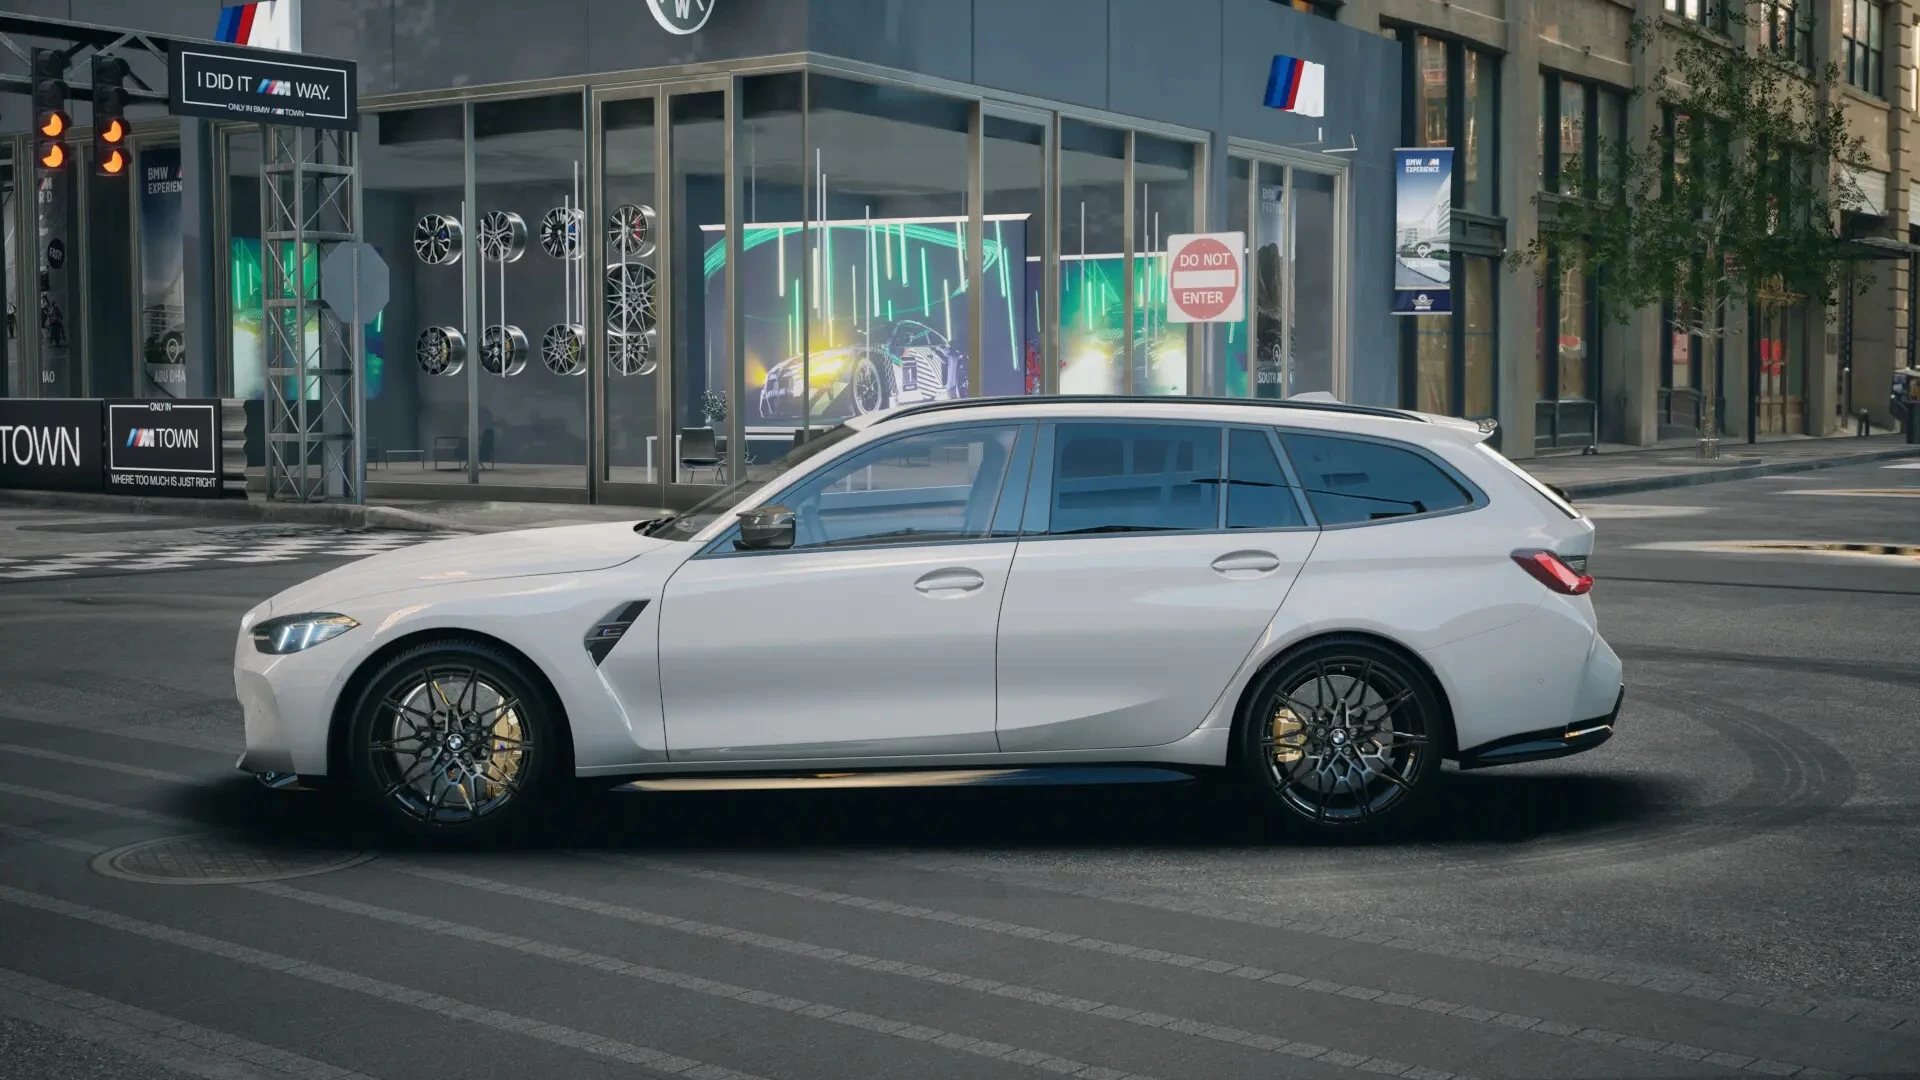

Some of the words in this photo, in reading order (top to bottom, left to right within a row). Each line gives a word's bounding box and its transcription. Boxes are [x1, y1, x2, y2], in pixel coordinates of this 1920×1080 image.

[197, 71, 201, 87] I
[206, 72, 233, 90] DID
[238, 75, 252, 92] IT
[296, 82, 330, 101] WAY.
[228, 103, 245, 111] ONLY
[285, 108, 304, 117] TOWN
[1405, 158, 1422, 166] BMW
[148, 167, 168, 180] BMW
[148, 181, 183, 194] EXPERIEN
[1180, 253, 1199, 267] DO
[1203, 252, 1231, 266] NOT
[1182, 291, 1224, 304] ENTER
[170, 369, 186, 383] DHA
[150, 402, 165, 411] ONLY
[165, 402, 171, 411] IN
[155, 428, 198, 448] TOWN
[0, 425, 80, 467] TOWN
[111, 474, 134, 484] WHERE
[135, 475, 149, 485] TOO
[150, 475, 170, 486] MUCH
[170, 476, 177, 486] IS
[178, 477, 195, 487] JUST
[195, 477, 217, 487] RIGHT
